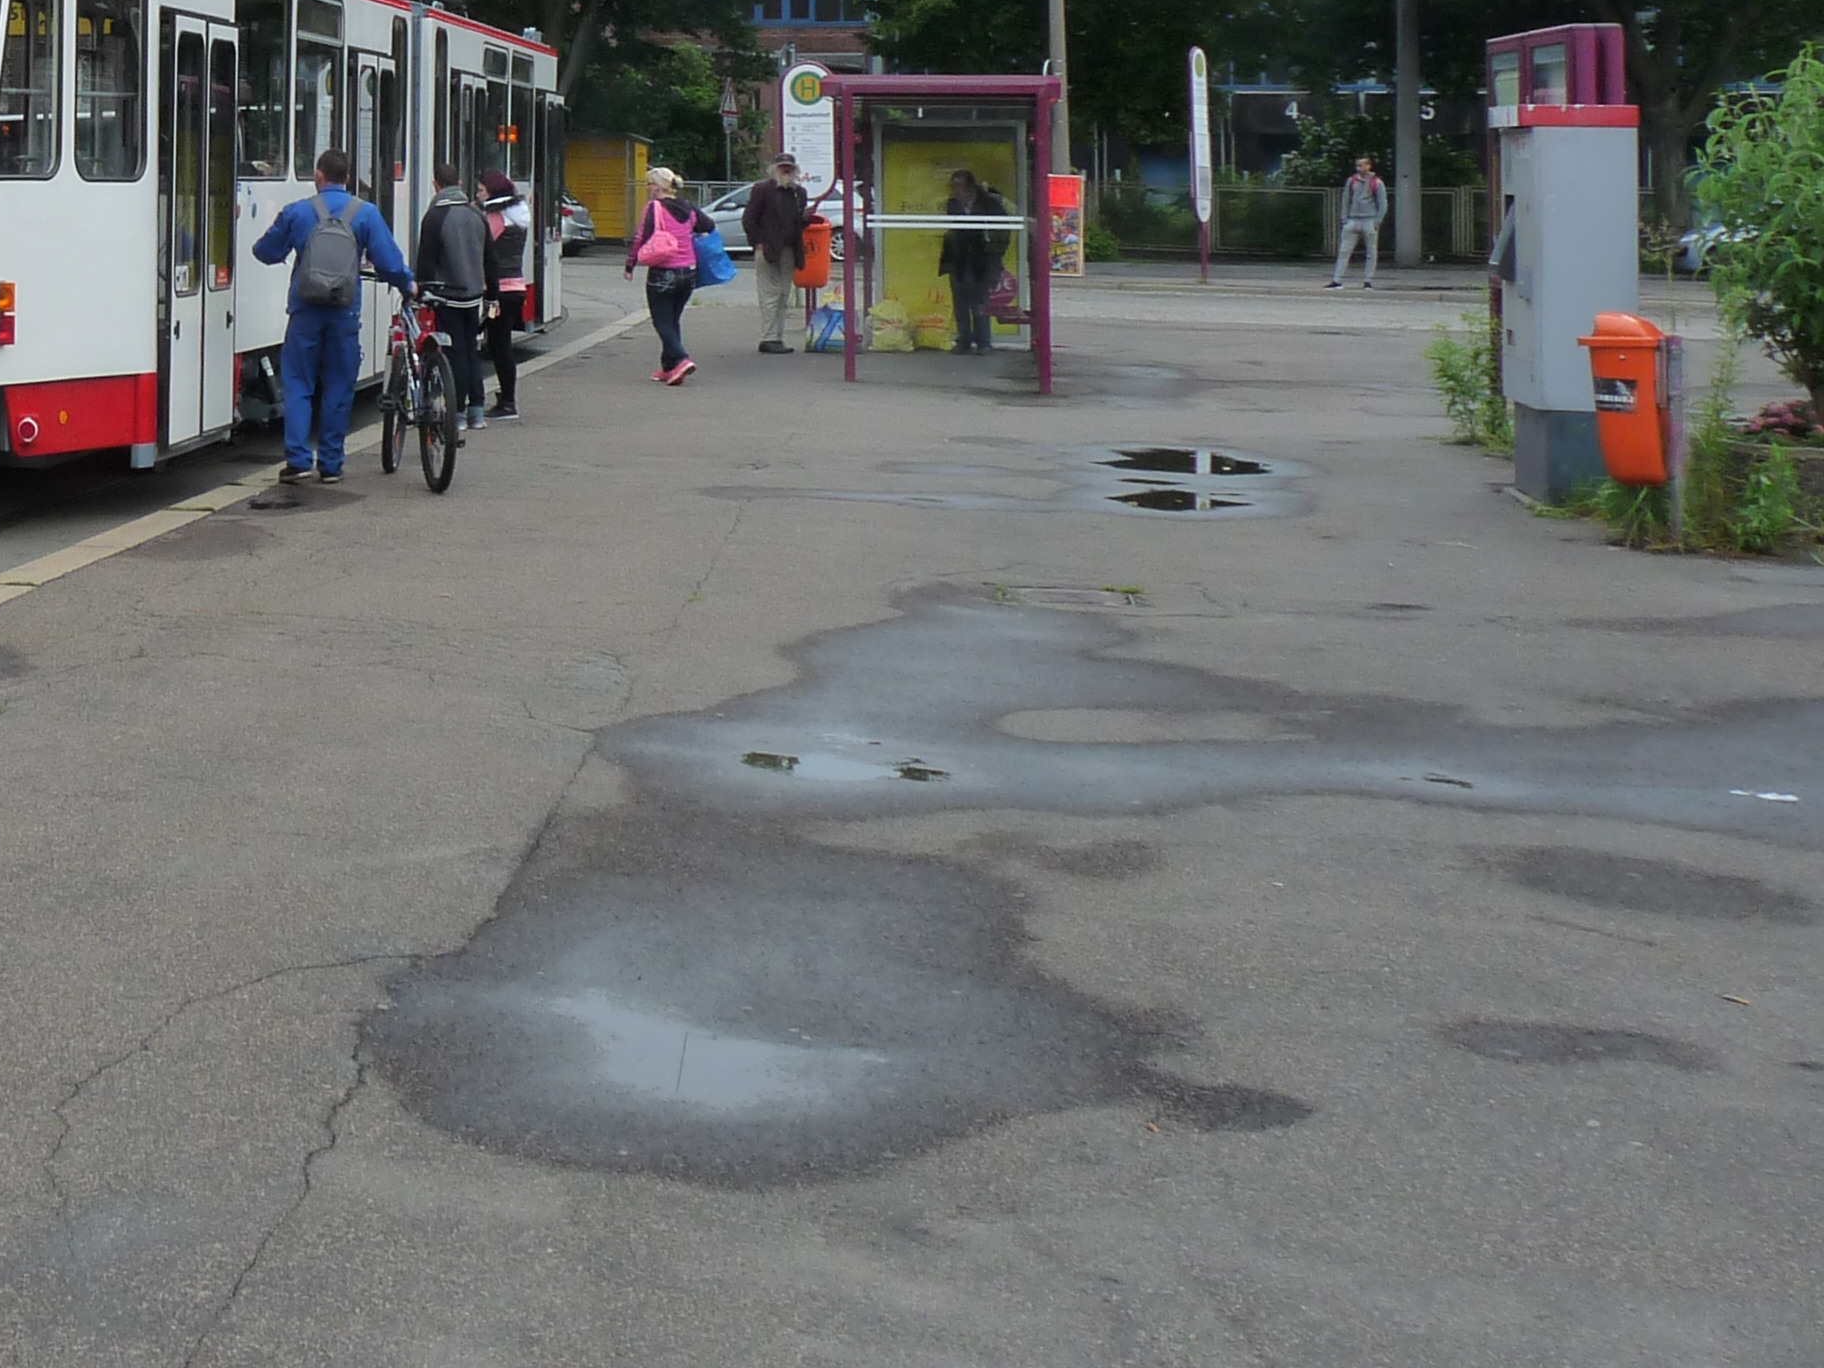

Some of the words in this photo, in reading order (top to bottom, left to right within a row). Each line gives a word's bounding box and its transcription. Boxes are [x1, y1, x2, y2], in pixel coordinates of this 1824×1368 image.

[800, 78, 816, 98] H
[1284, 101, 1299, 120] 4
[1420, 101, 1436, 121] 5
